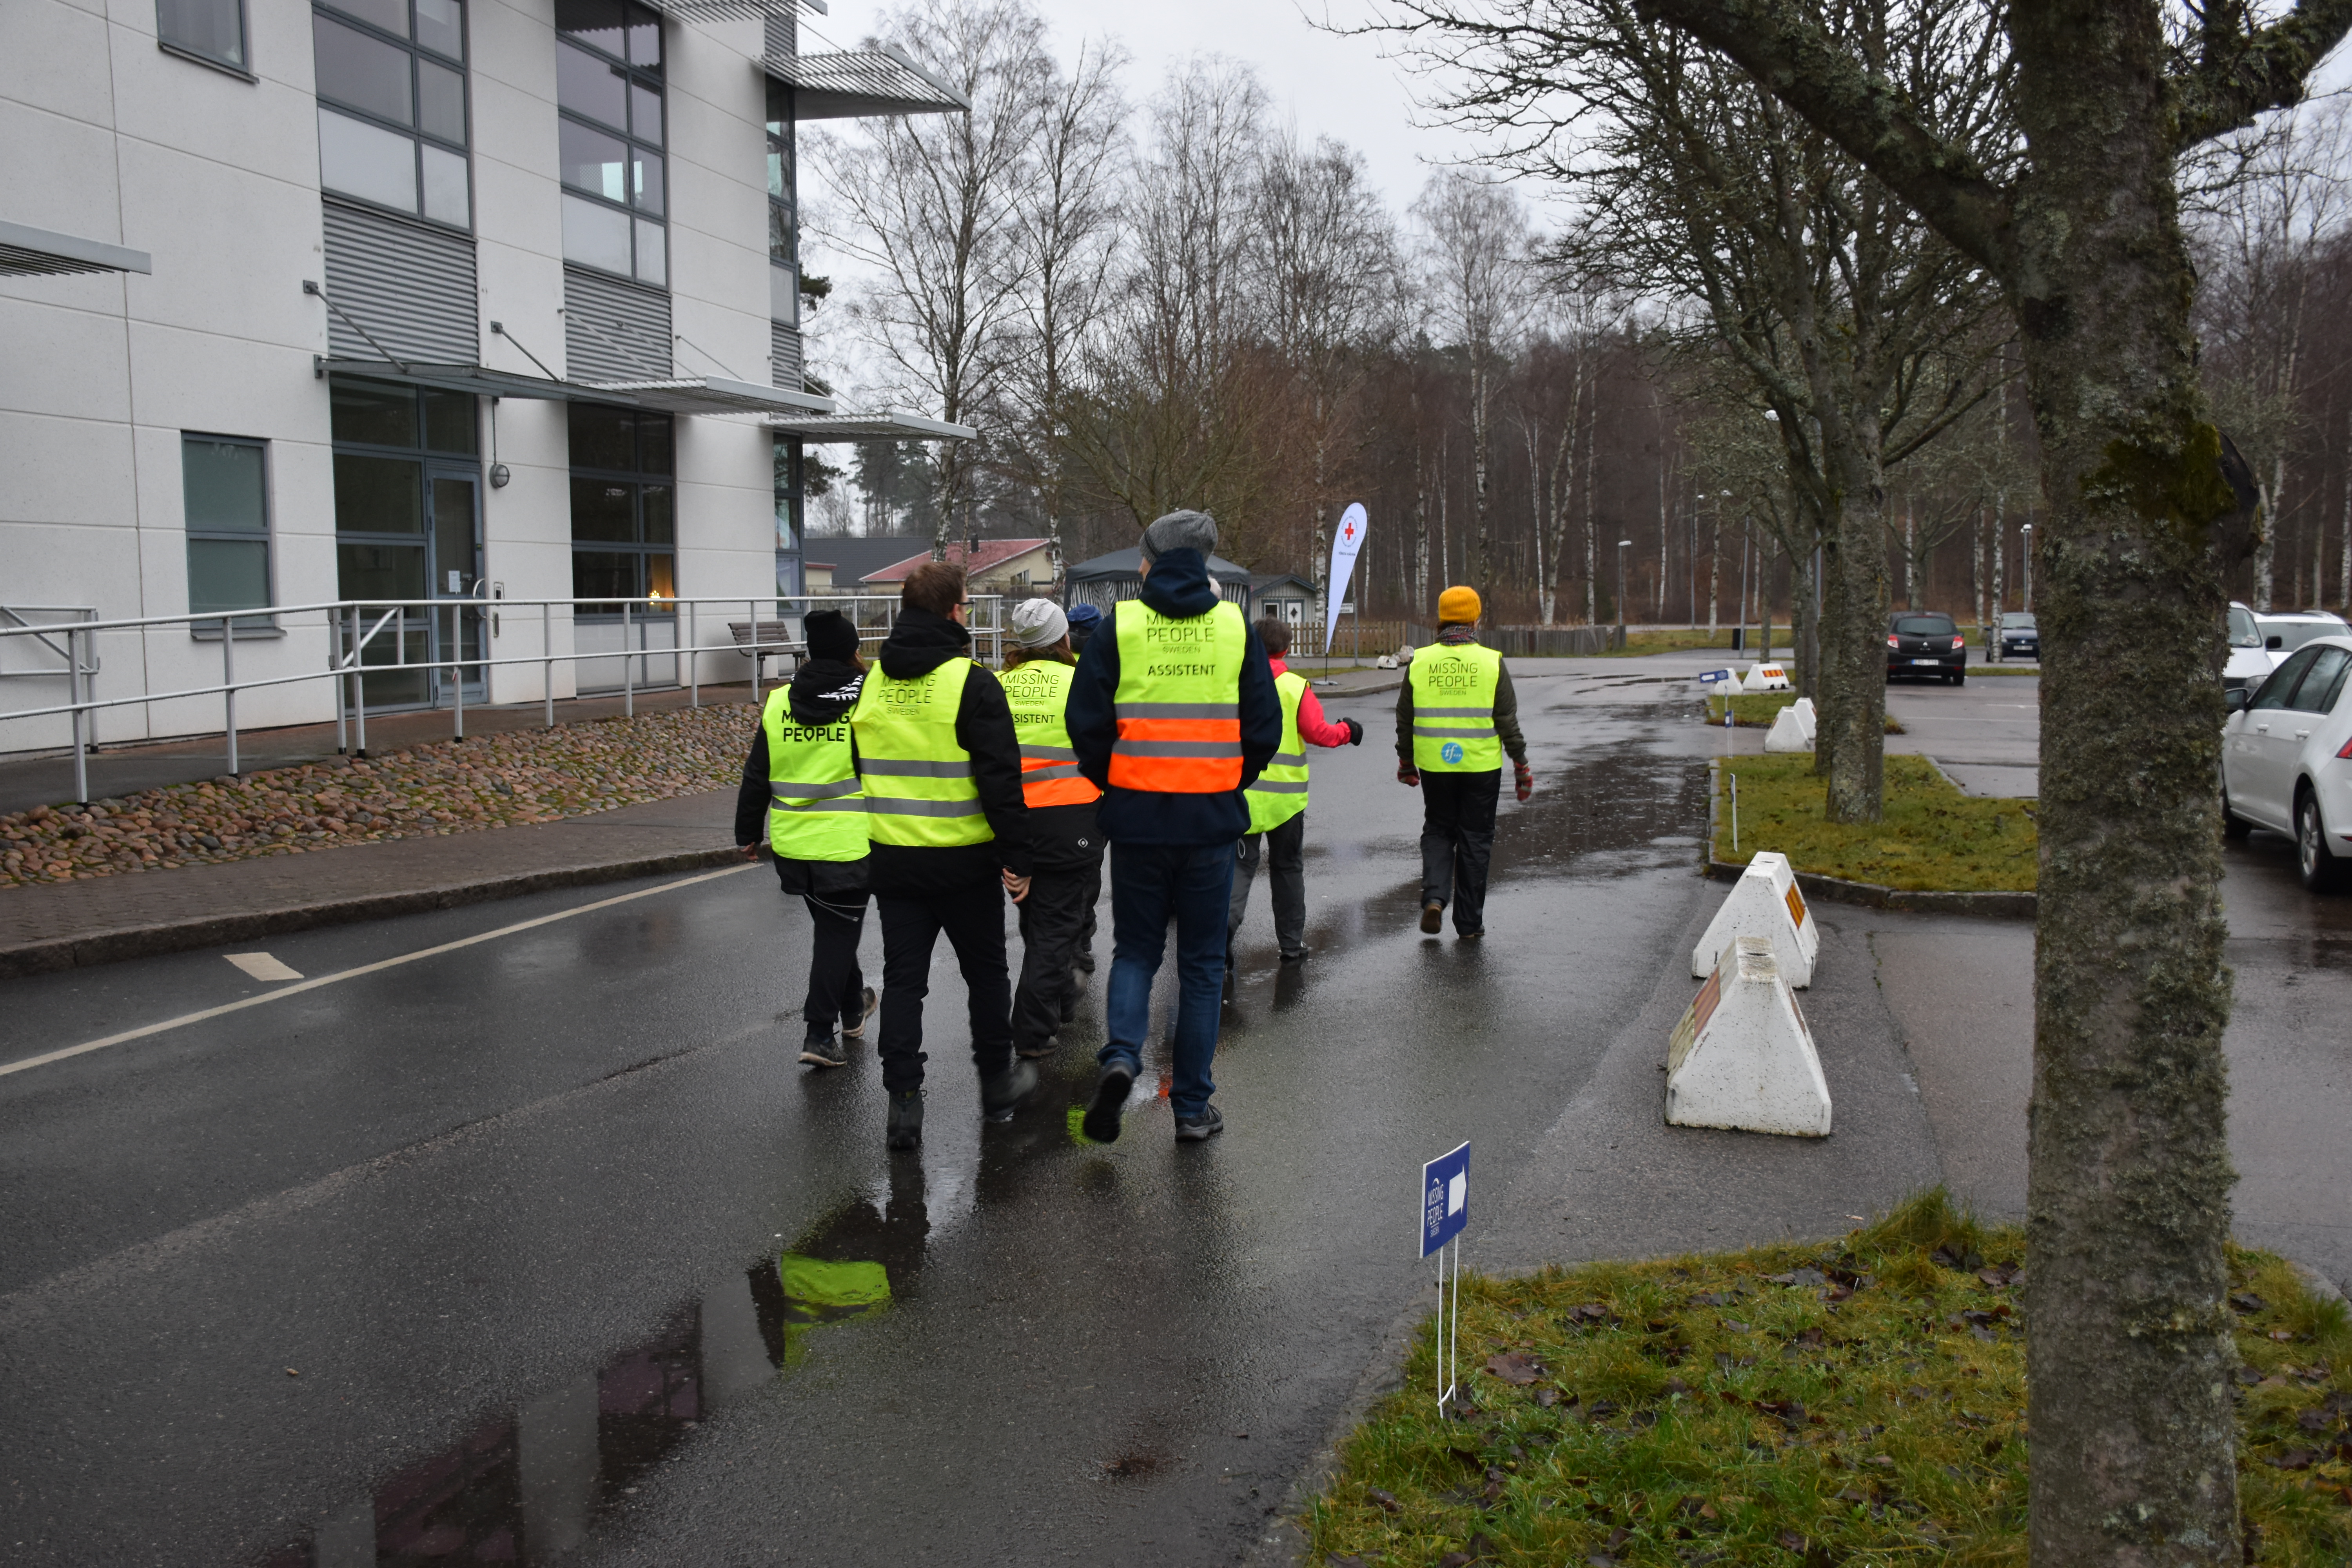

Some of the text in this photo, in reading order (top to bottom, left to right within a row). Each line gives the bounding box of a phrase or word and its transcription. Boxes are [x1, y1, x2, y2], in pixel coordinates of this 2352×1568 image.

[1147, 627, 1214, 642] PEOPLE
[1147, 664, 1216, 676] ASSISTENT
[1429, 663, 1478, 673] MISSING
[1005, 674, 1059, 684] MISSING
[1429, 675, 1477, 687] PEOPLE
[877, 689, 933, 704] PEOPLE
[1005, 686, 1058, 697] PEOPLE
[886, 707, 920, 715] SWEDEN
[1011, 714, 1056, 724] SISTENT
[783, 727, 846, 742] PEOPLE
[1428, 1184, 1444, 1206] MISSING
[1427, 1203, 1444, 1227] PEOPLE
